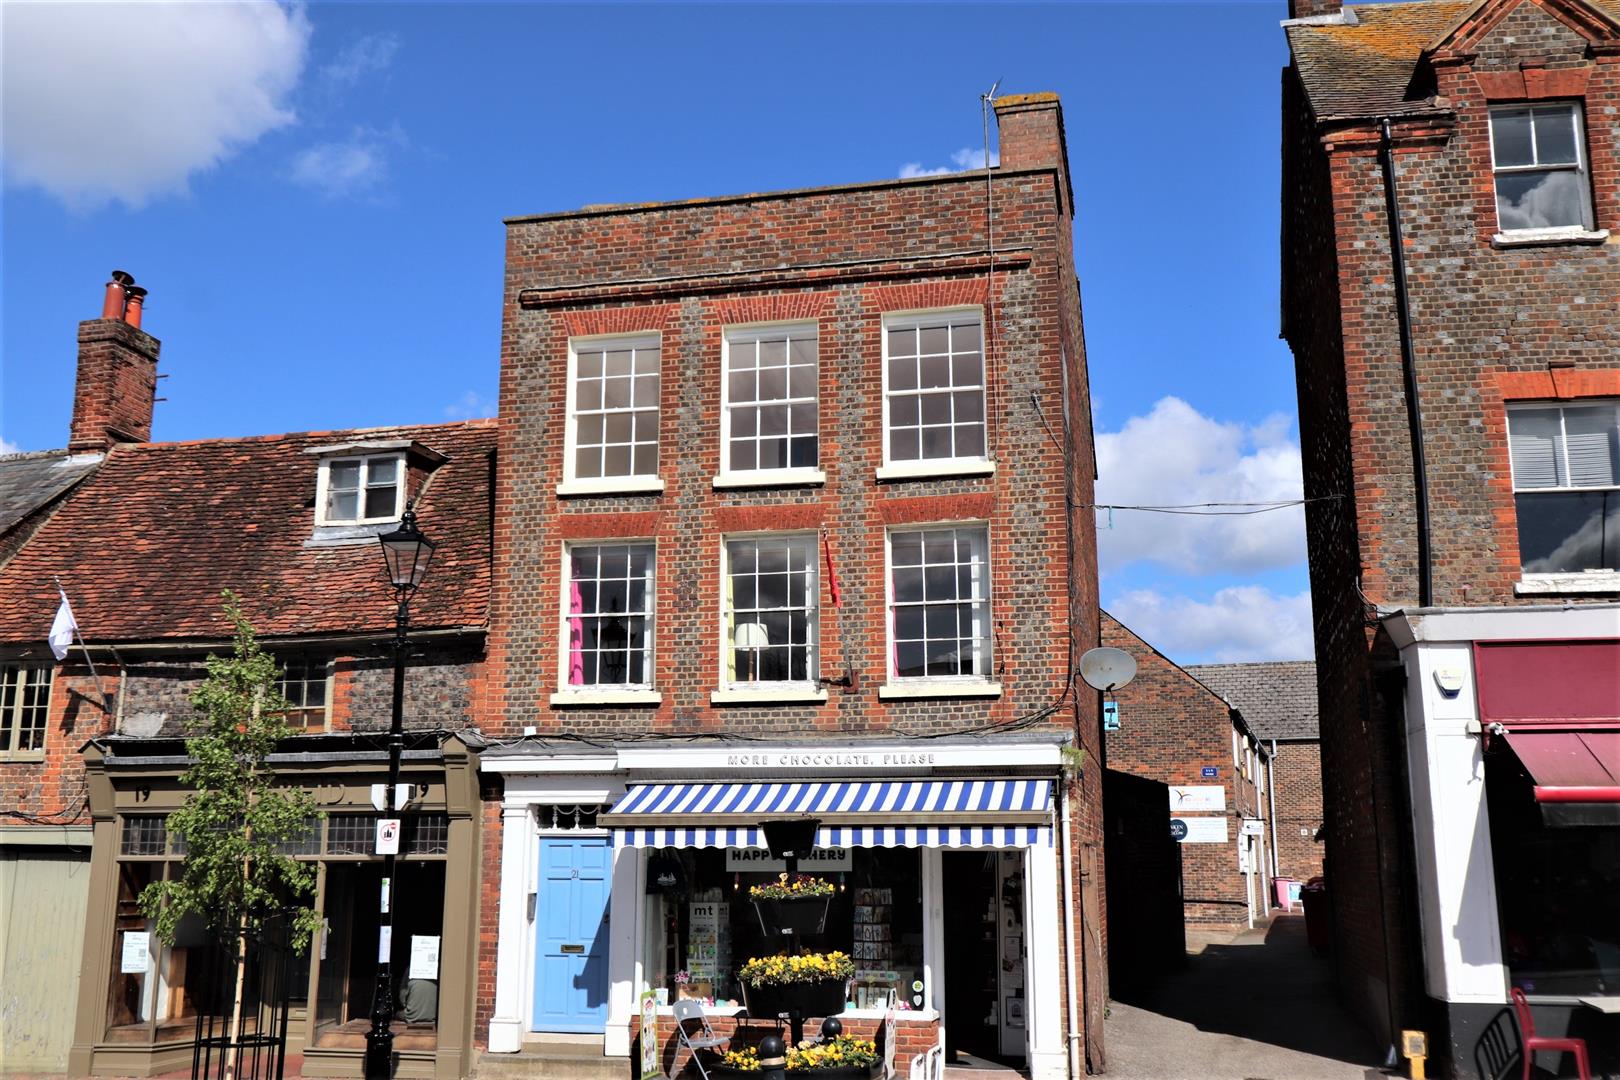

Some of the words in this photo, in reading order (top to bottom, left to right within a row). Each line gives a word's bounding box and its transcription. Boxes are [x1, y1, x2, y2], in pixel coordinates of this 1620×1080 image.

[727, 754, 768, 766] MORE
[883, 753, 936, 766] PLEASE
[136, 786, 150, 803] 19
[732, 850, 776, 861] HAPP
[571, 869, 579, 879] 21
[694, 905, 713, 916] mt
